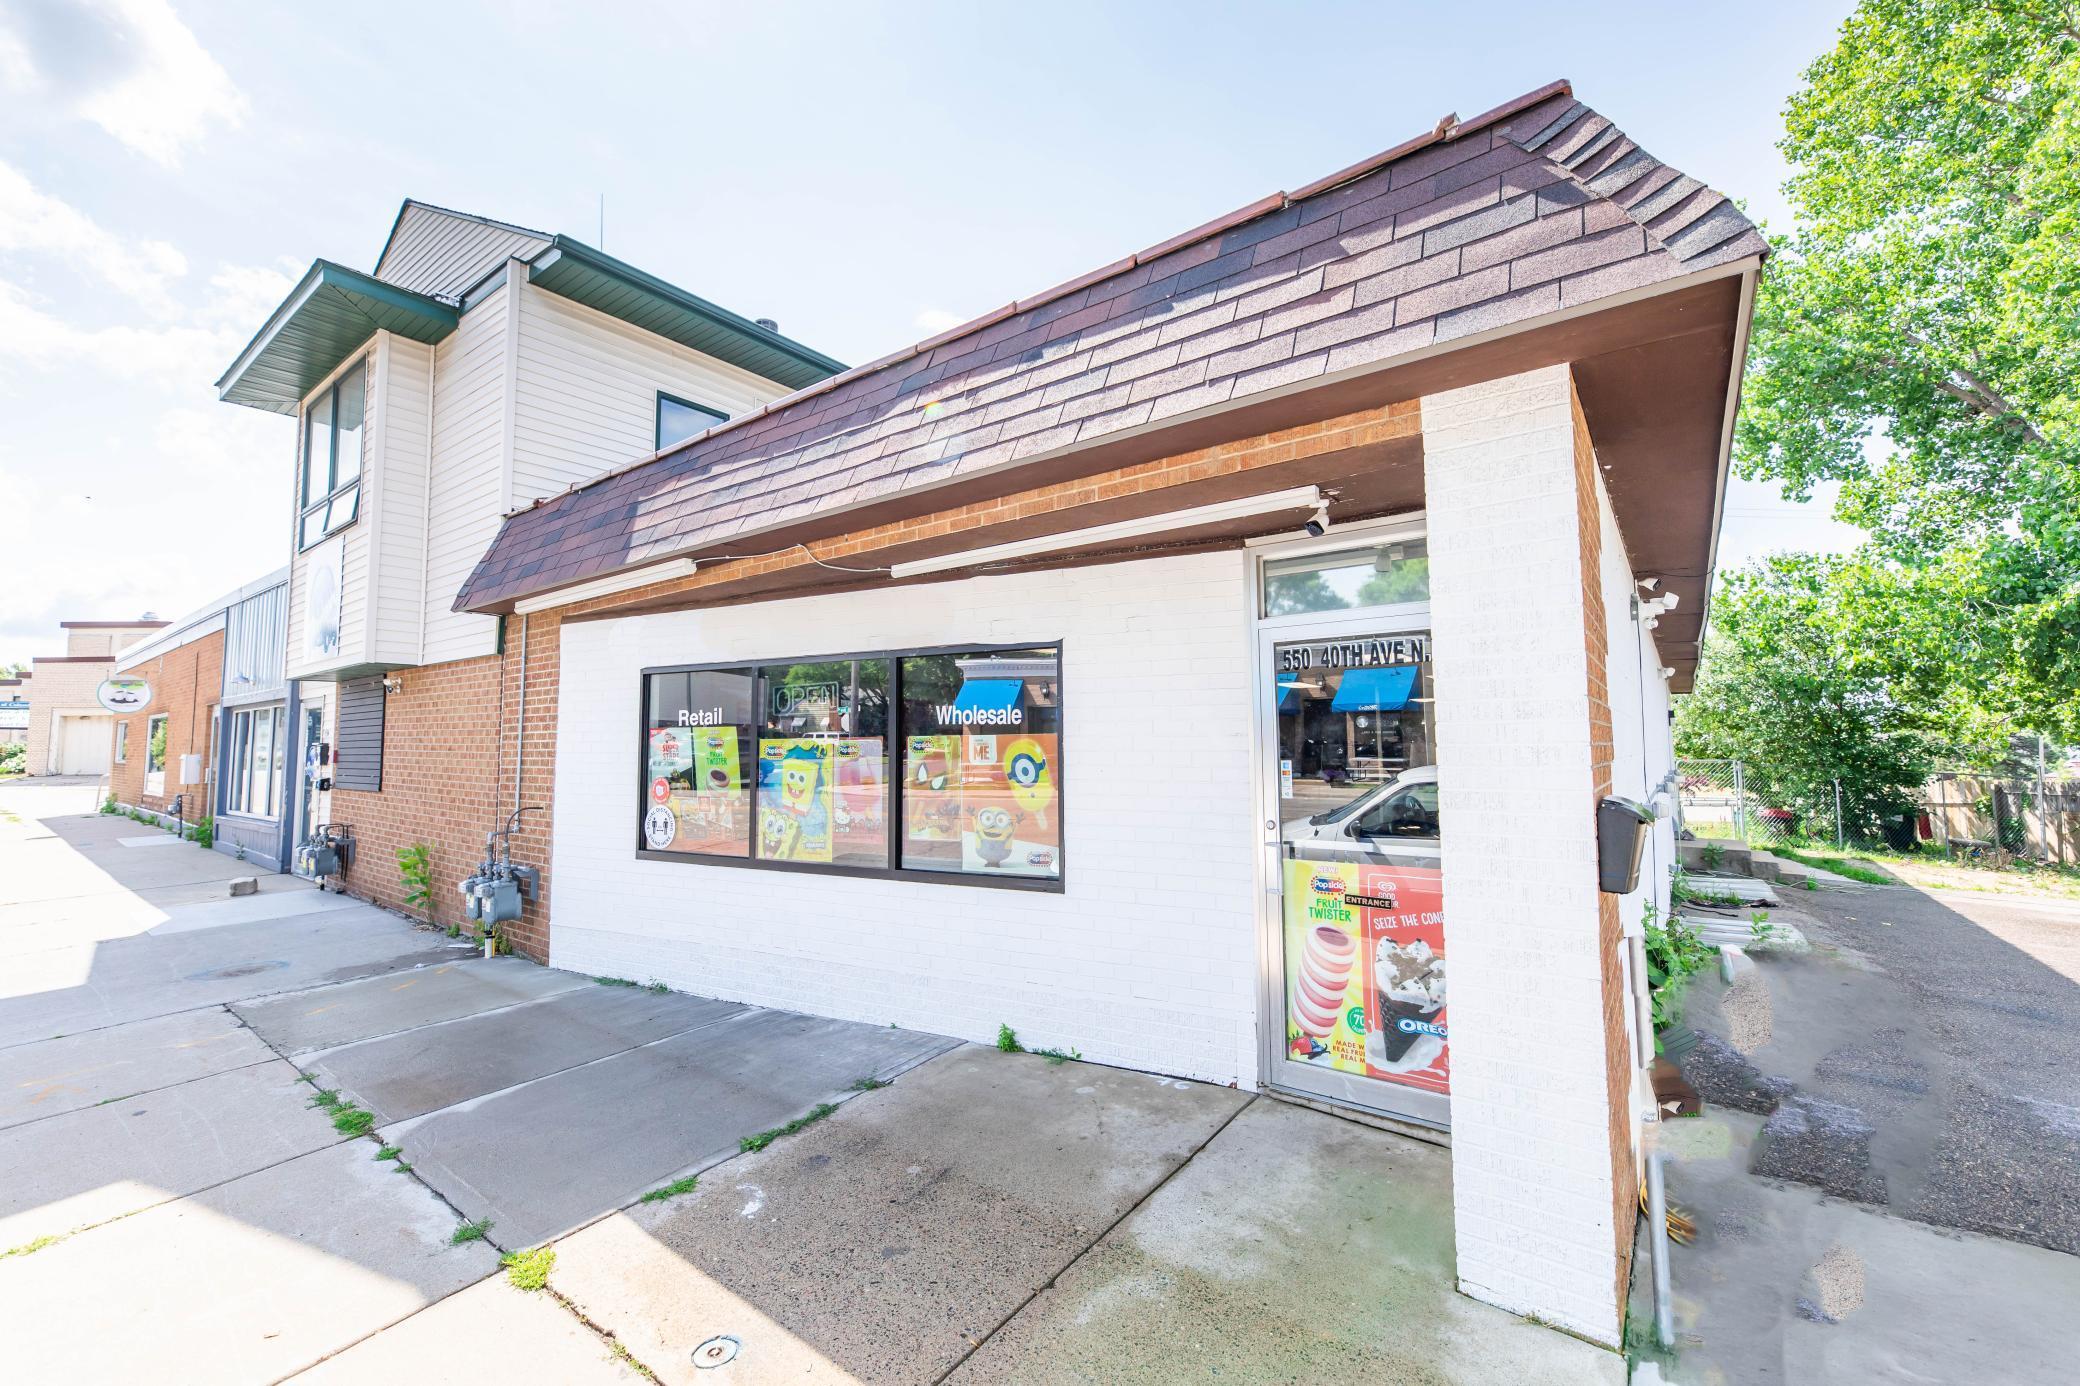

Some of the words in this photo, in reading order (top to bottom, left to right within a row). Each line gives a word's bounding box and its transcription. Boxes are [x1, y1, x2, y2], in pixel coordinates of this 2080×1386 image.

[1283, 646, 1312, 671] 550
[1321, 643, 1365, 668] 40TH
[1370, 639, 1405, 665] AVE
[1411, 638, 1431, 662] N.
[776, 684, 836, 712] OPEN
[678, 707, 723, 726] Retail
[936, 704, 1023, 725] Wholesale
[973, 744, 990, 761] ME
[1345, 896, 1391, 909] ENTRANCE
[1308, 906, 1351, 922] TWISTER
[1373, 915, 1399, 930] SEIZE
[1400, 913, 1419, 927] THE
[1399, 1018, 1448, 1036] OREO
[1332, 1045, 1349, 1054] REAL
[1335, 1039, 1356, 1049] MADE
[1340, 1053, 1357, 1062] REAL
